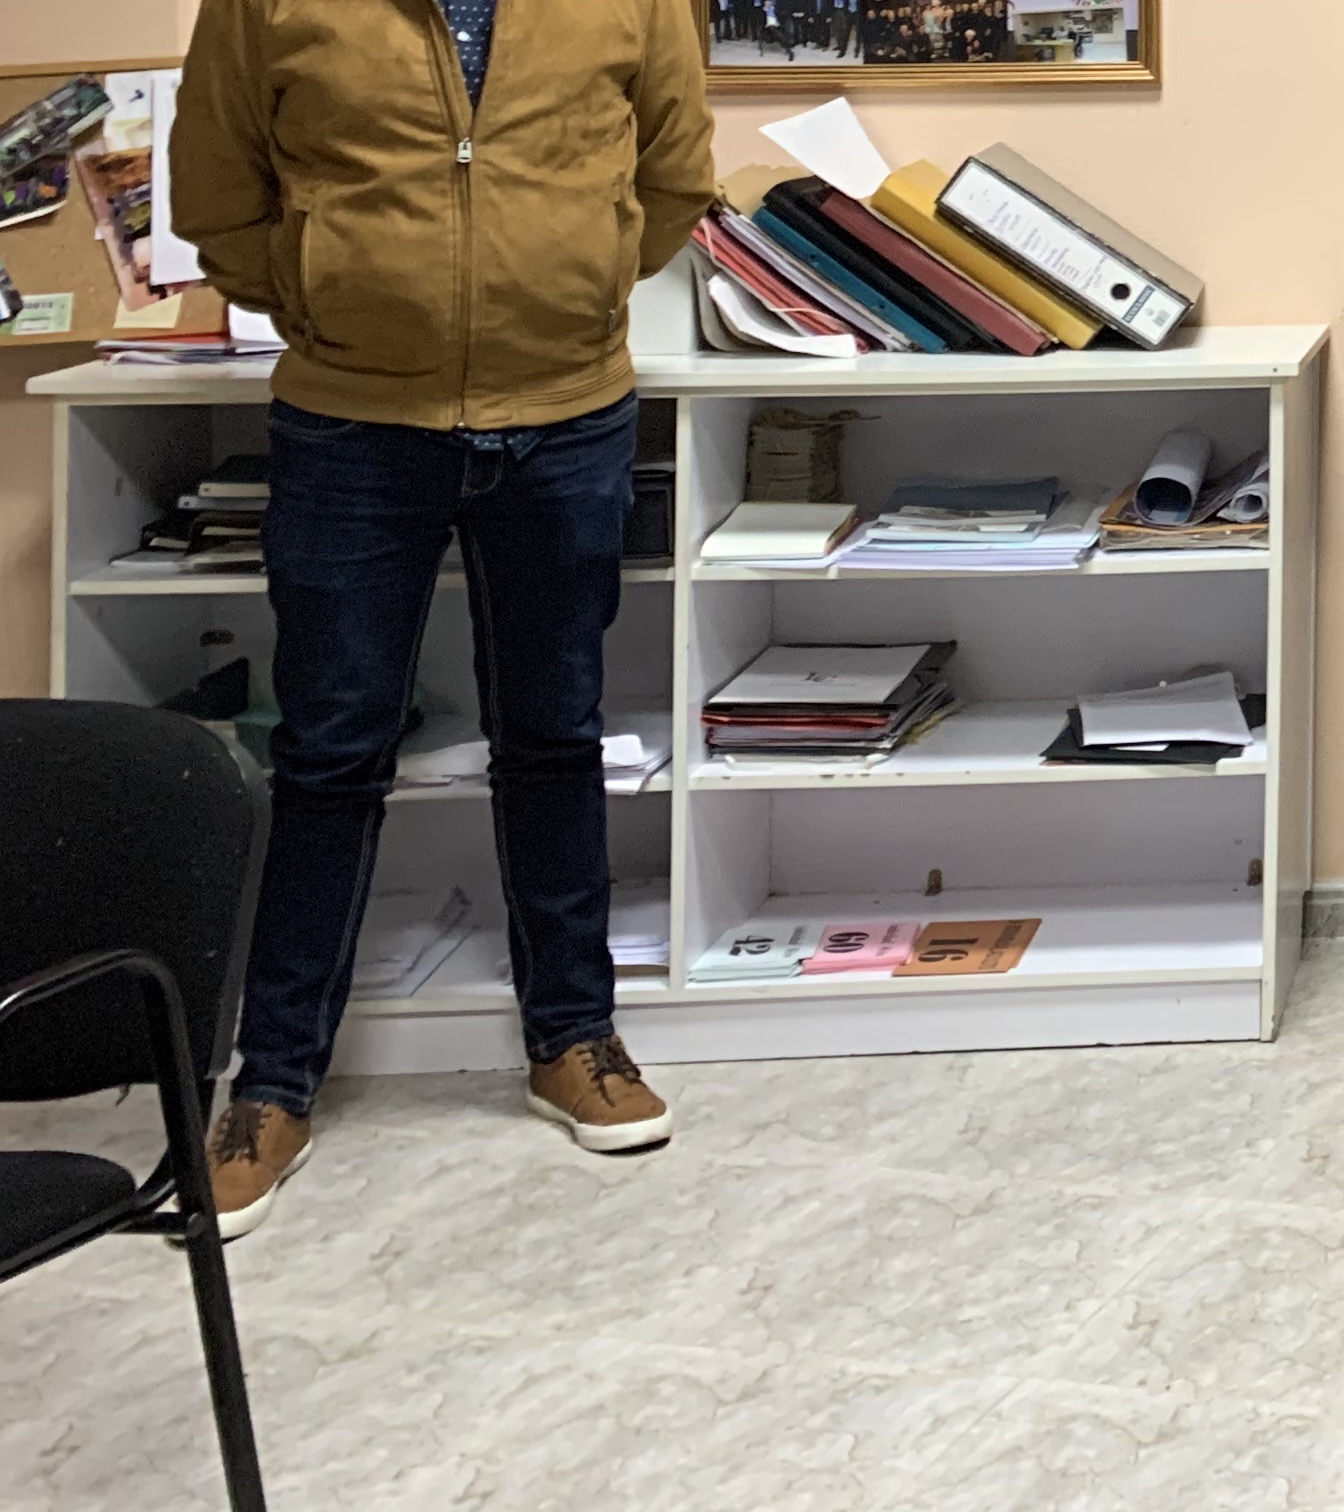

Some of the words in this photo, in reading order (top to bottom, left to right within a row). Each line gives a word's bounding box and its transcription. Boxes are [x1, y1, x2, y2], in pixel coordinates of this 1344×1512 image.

[729, 934, 776, 956] 42
[822, 931, 869, 954] 60
[918, 935, 980, 963] 16
